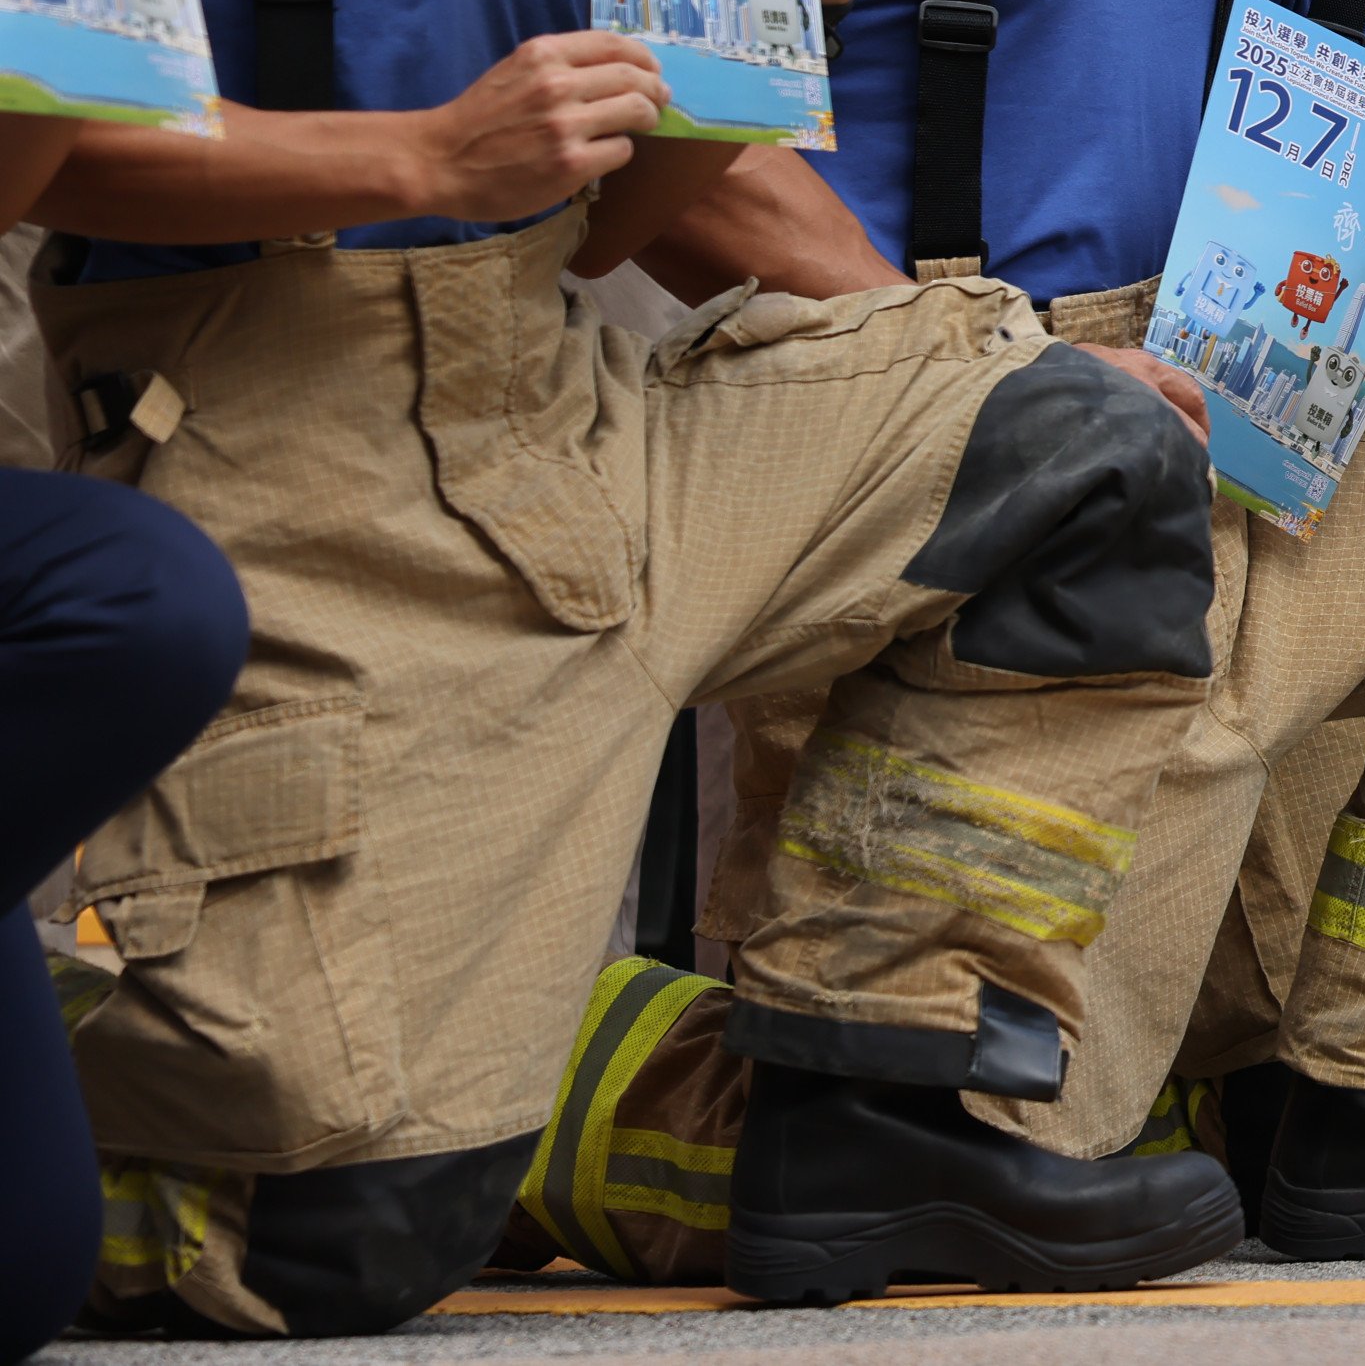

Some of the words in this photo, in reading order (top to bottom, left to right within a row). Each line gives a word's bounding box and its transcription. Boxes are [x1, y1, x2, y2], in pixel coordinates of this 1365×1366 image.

[1245, 9, 1307, 50] 投入選舉
[1267, 36, 1290, 53] Election
[1290, 47, 1316, 66] Together
[1325, 65, 1344, 80] Create
[1228, 68, 1349, 180] 12月7日
[1338, 162, 1353, 187] DEC
[1296, 284, 1324, 306] 投票箱
[1307, 403, 1334, 427] 投票箱
